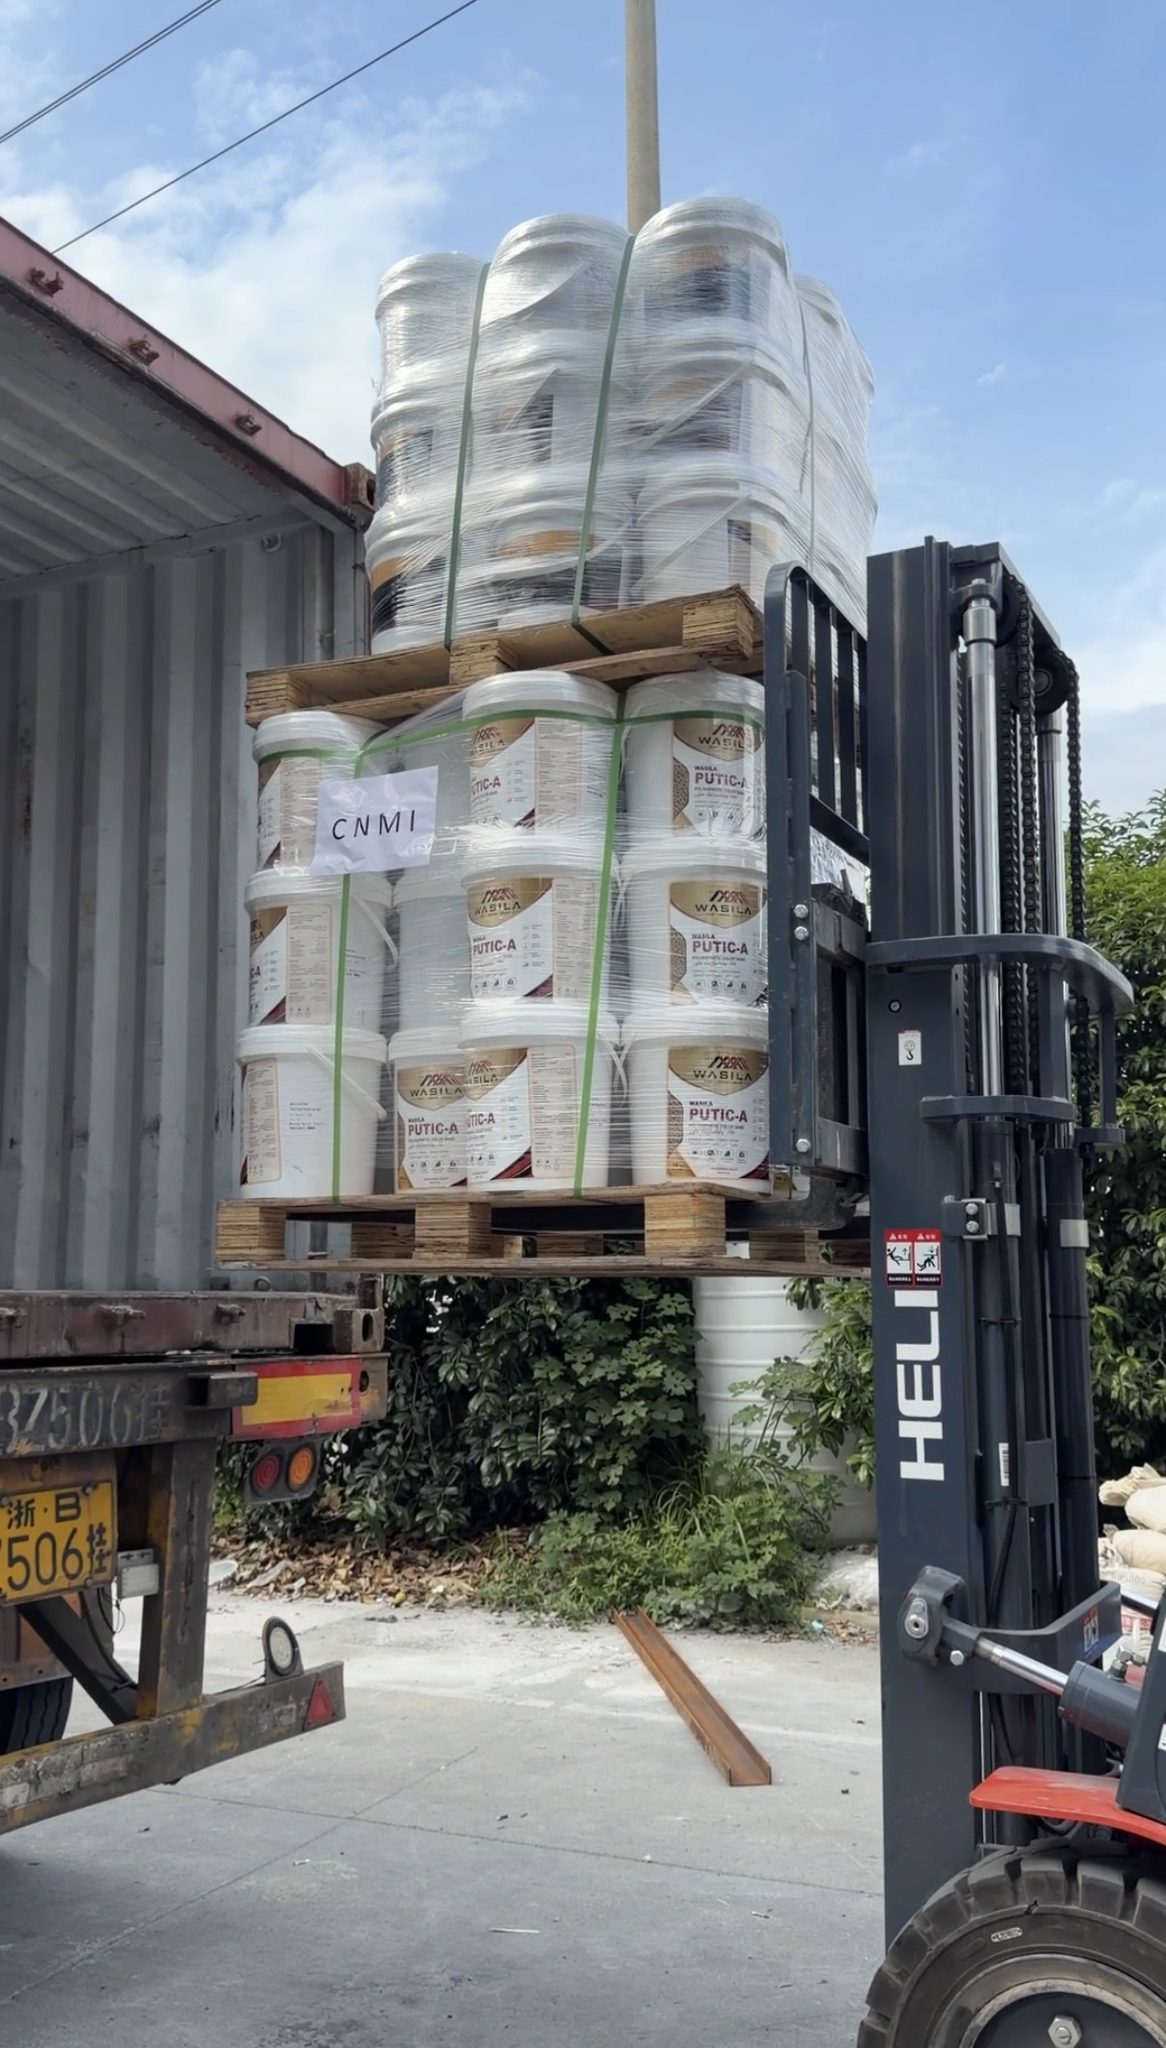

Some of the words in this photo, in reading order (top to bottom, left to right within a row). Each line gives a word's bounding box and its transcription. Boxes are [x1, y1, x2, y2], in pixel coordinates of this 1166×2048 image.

[698, 736, 751, 750] WASIL
[332, 809, 416, 841] CNMI
[694, 903, 752, 915] WASILA
[473, 938, 517, 956] PUTIC-A
[692, 940, 749, 955] PUTIC-A
[692, 1070, 752, 1081] WASILA
[409, 1086, 464, 1097] WASILA
[690, 1108, 748, 1123] PUTIC-A
[408, 1122, 459, 1136] PUTIC-A
[894, 1289, 945, 1481] HELI
[0, 1522, 107, 1592] 506挂
